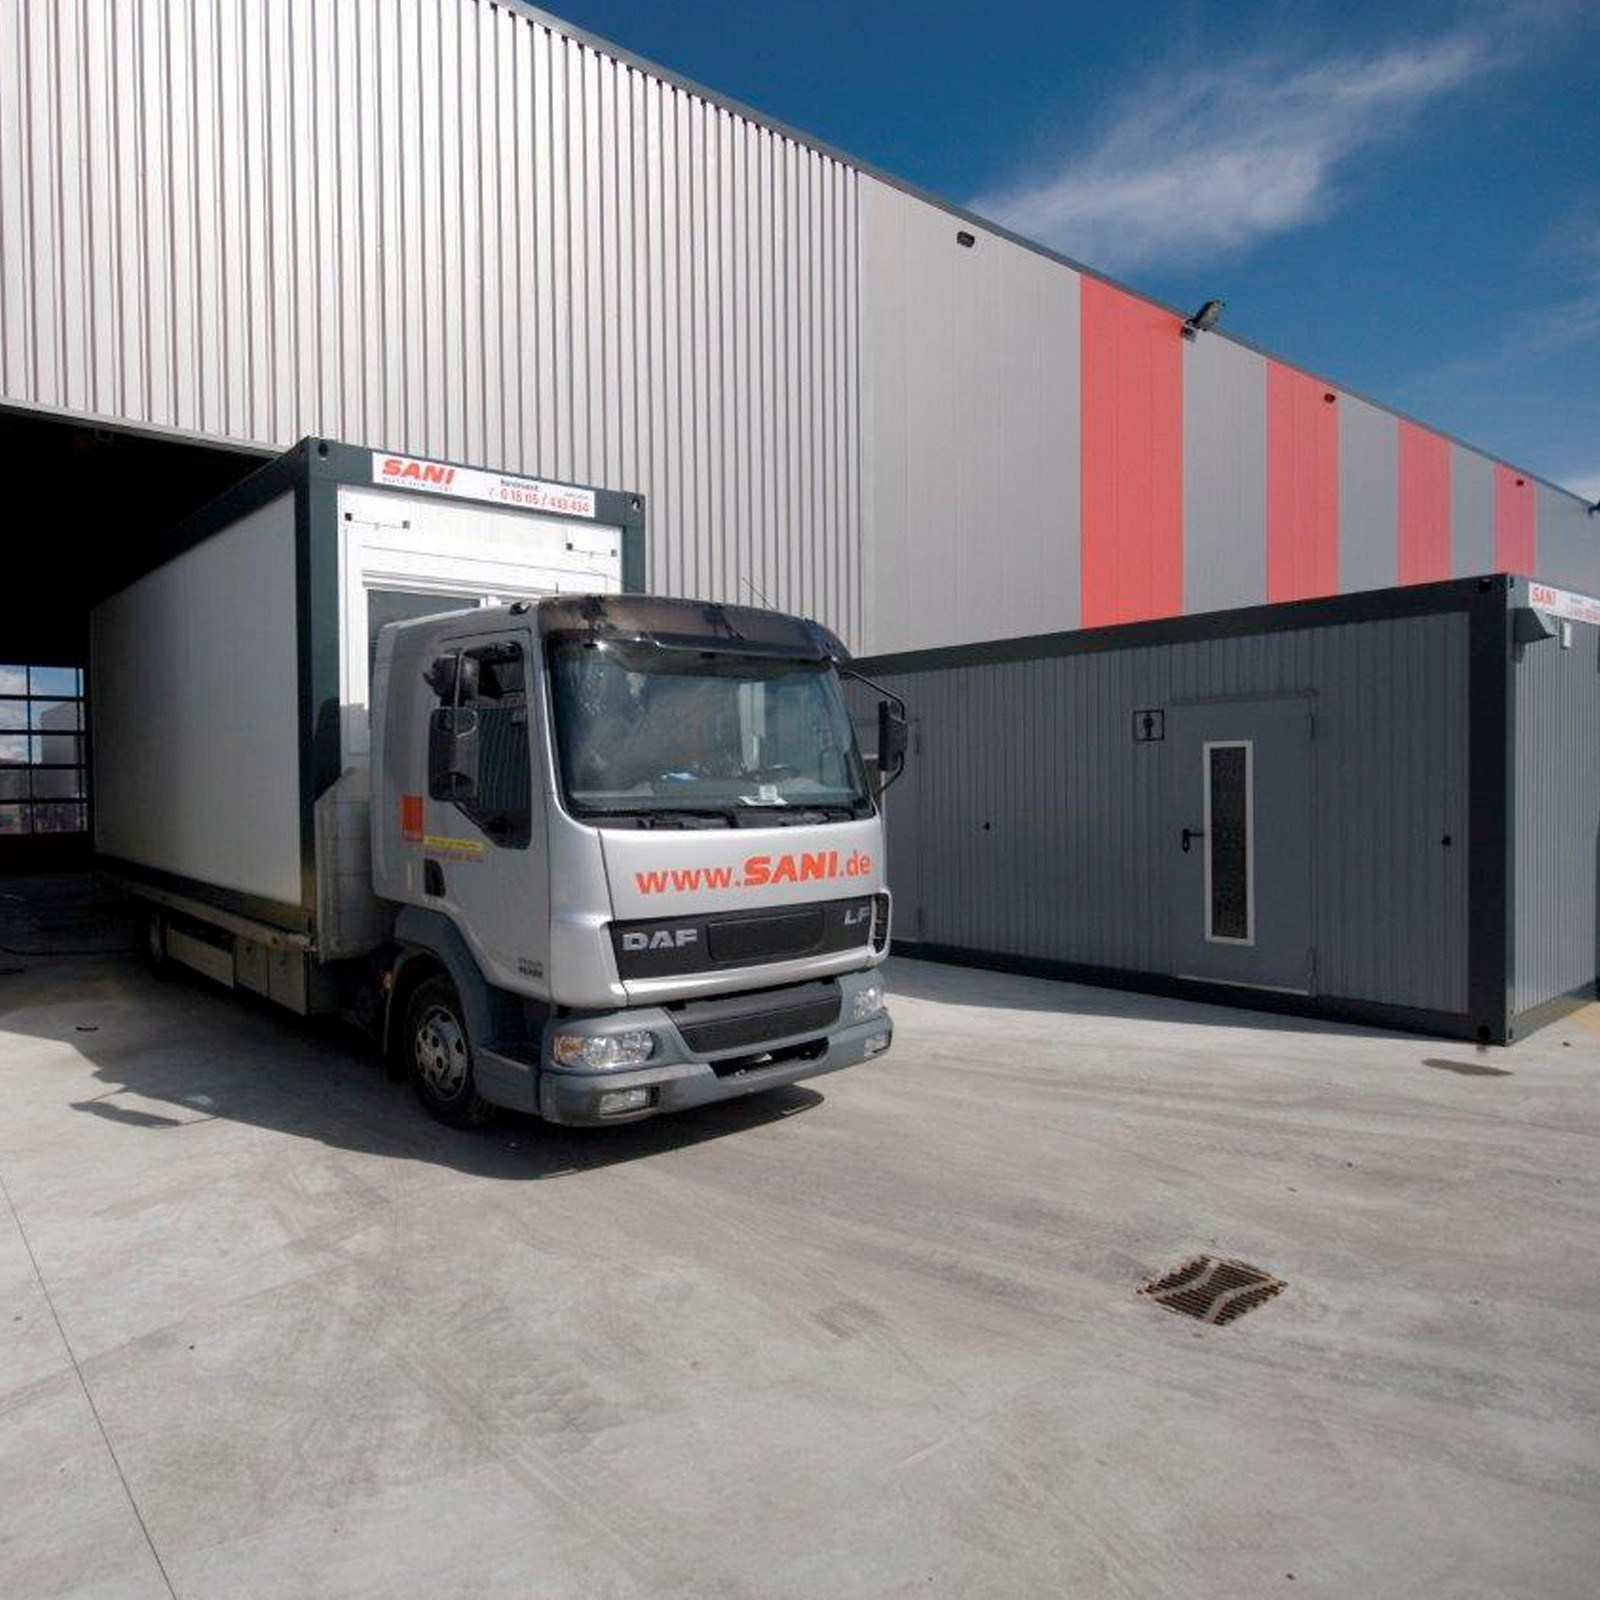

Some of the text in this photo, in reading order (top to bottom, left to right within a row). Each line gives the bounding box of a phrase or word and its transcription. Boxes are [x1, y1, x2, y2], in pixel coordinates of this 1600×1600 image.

[382, 459, 456, 484] SANI
[636, 850, 872, 894] www.SANI.de
[622, 929, 697, 950] DAF
